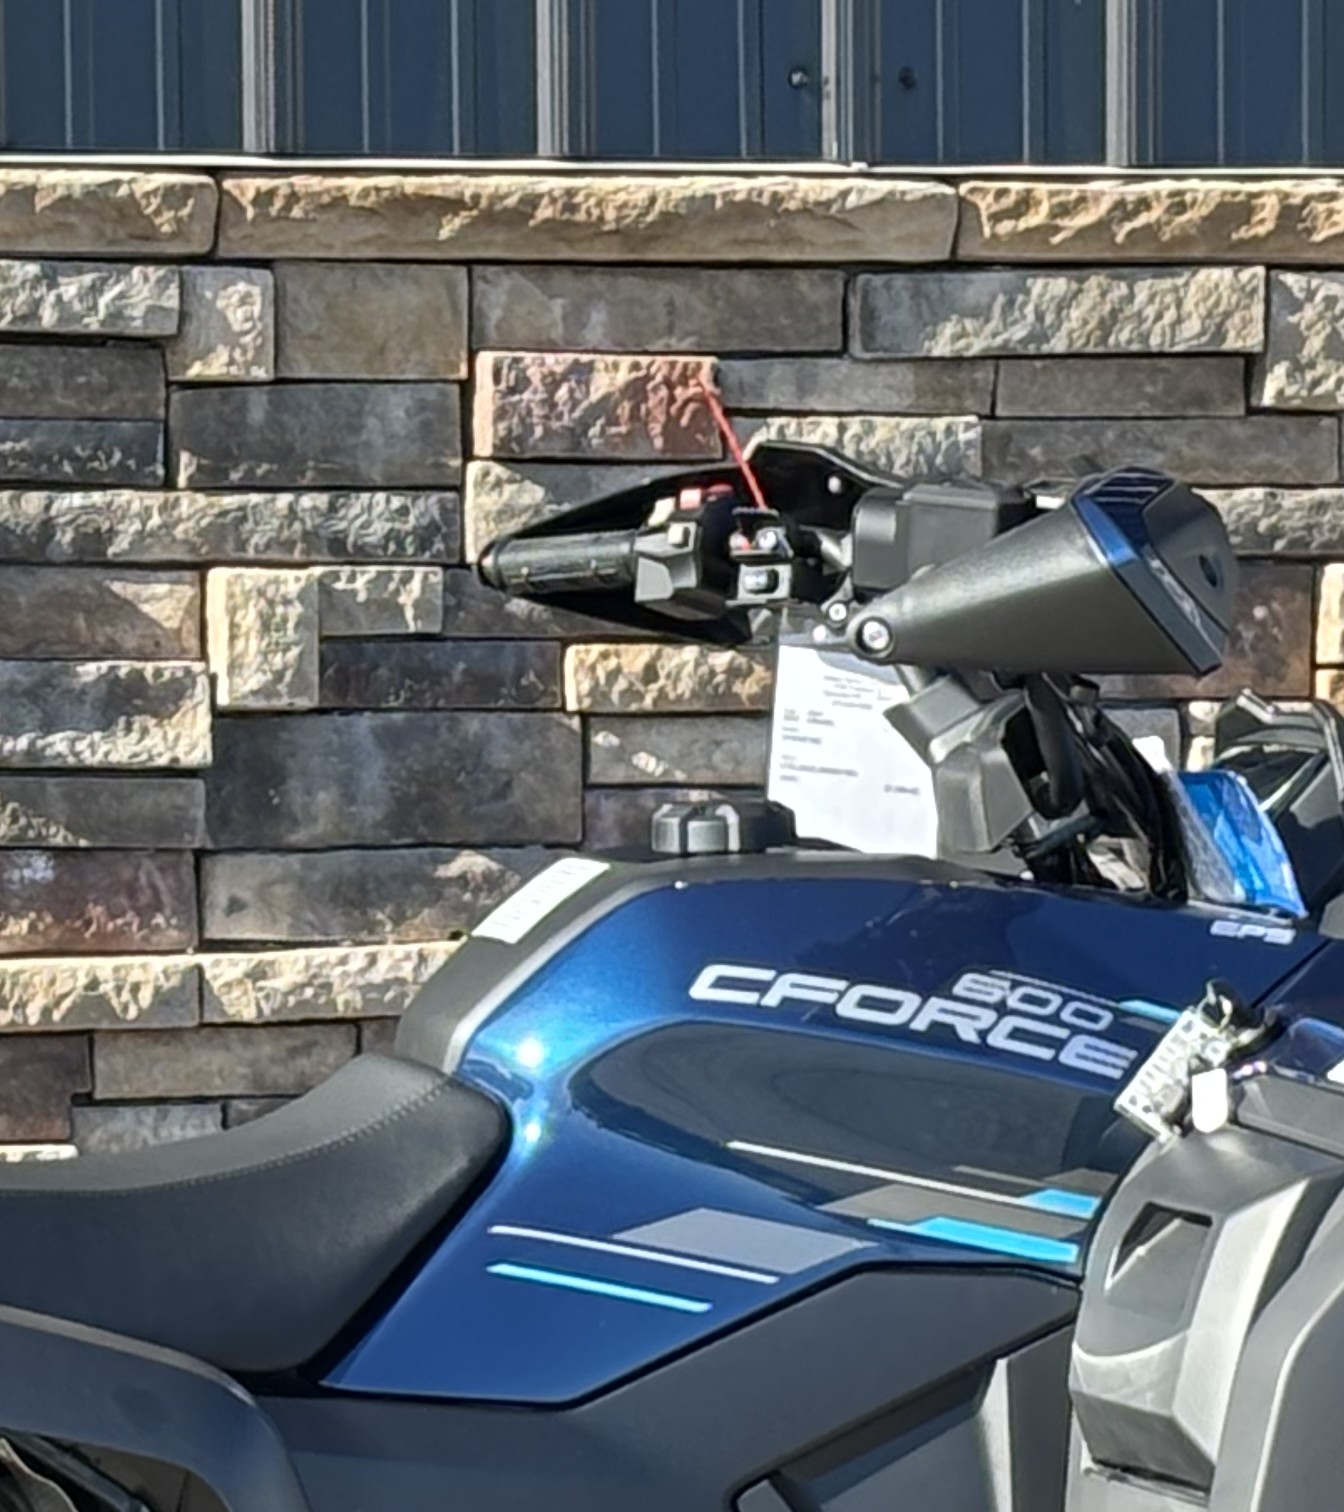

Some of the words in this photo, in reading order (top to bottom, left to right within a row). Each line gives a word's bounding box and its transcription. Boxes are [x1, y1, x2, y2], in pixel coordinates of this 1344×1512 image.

[1210, 919, 1296, 945] EPS
[689, 962, 1140, 1079] CFORCE
[952, 972, 1114, 1031] 600
